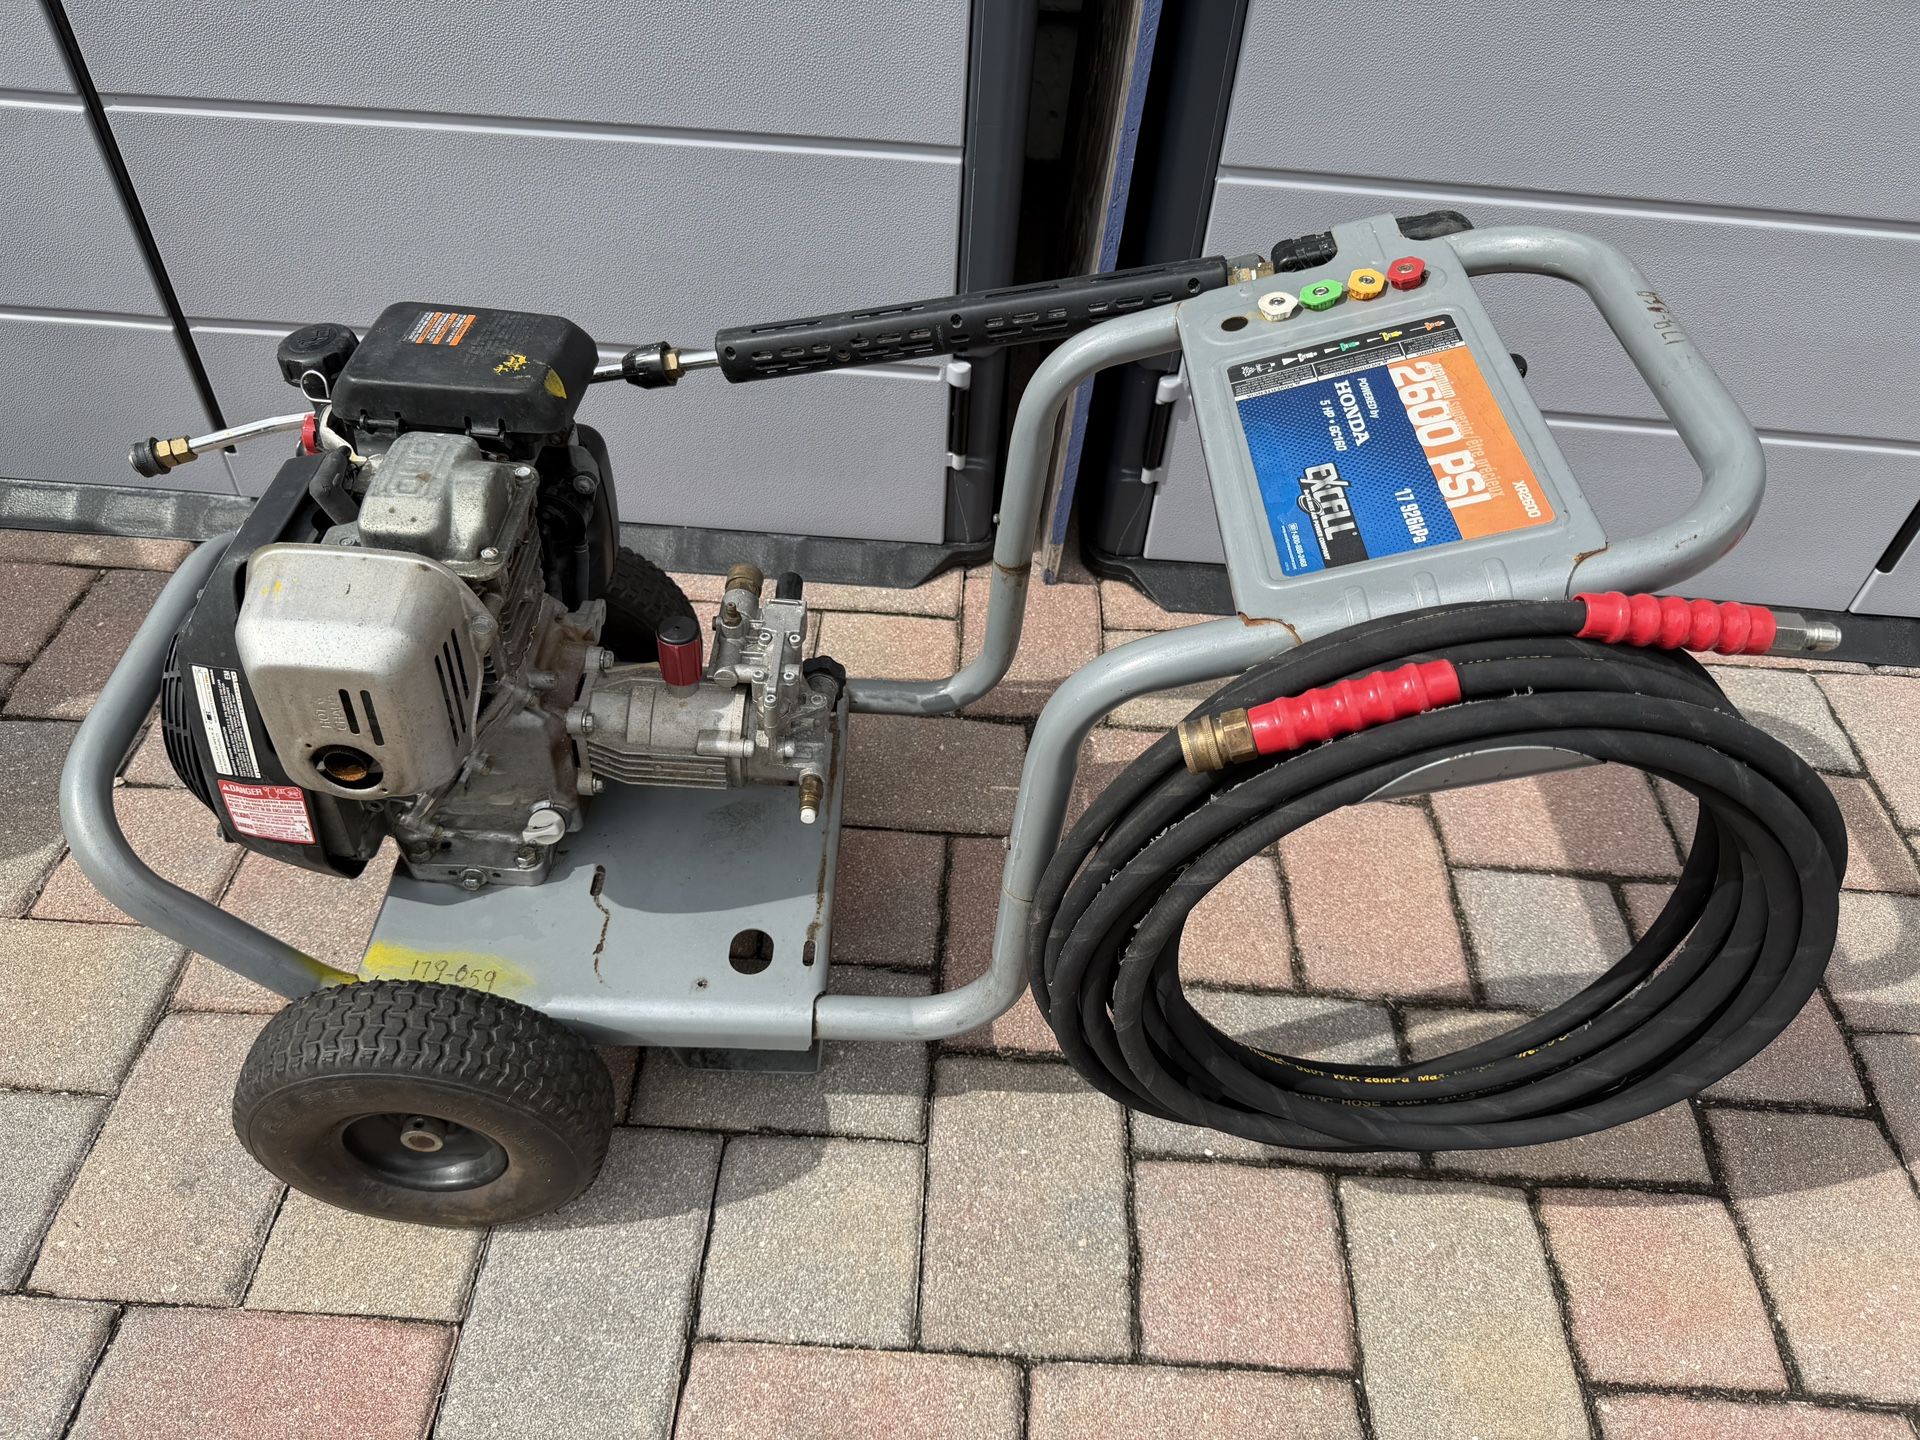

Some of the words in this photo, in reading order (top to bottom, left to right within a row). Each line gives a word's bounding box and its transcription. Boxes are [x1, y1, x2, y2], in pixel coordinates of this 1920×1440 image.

[1334, 379, 1370, 447] HONDA
[1357, 377, 1378, 410] POWERED
[1369, 409, 1380, 419] by
[1322, 407, 1336, 418] HP
[1329, 425, 1348, 451] GC160
[1388, 361, 1463, 447] 2600
[1427, 449, 1492, 509] PSI
[1395, 487, 1415, 501] 17
[1511, 480, 1541, 518] XR2600
[229, 785, 263, 796] DANGER
[411, 959, 498, 991] 179-059
